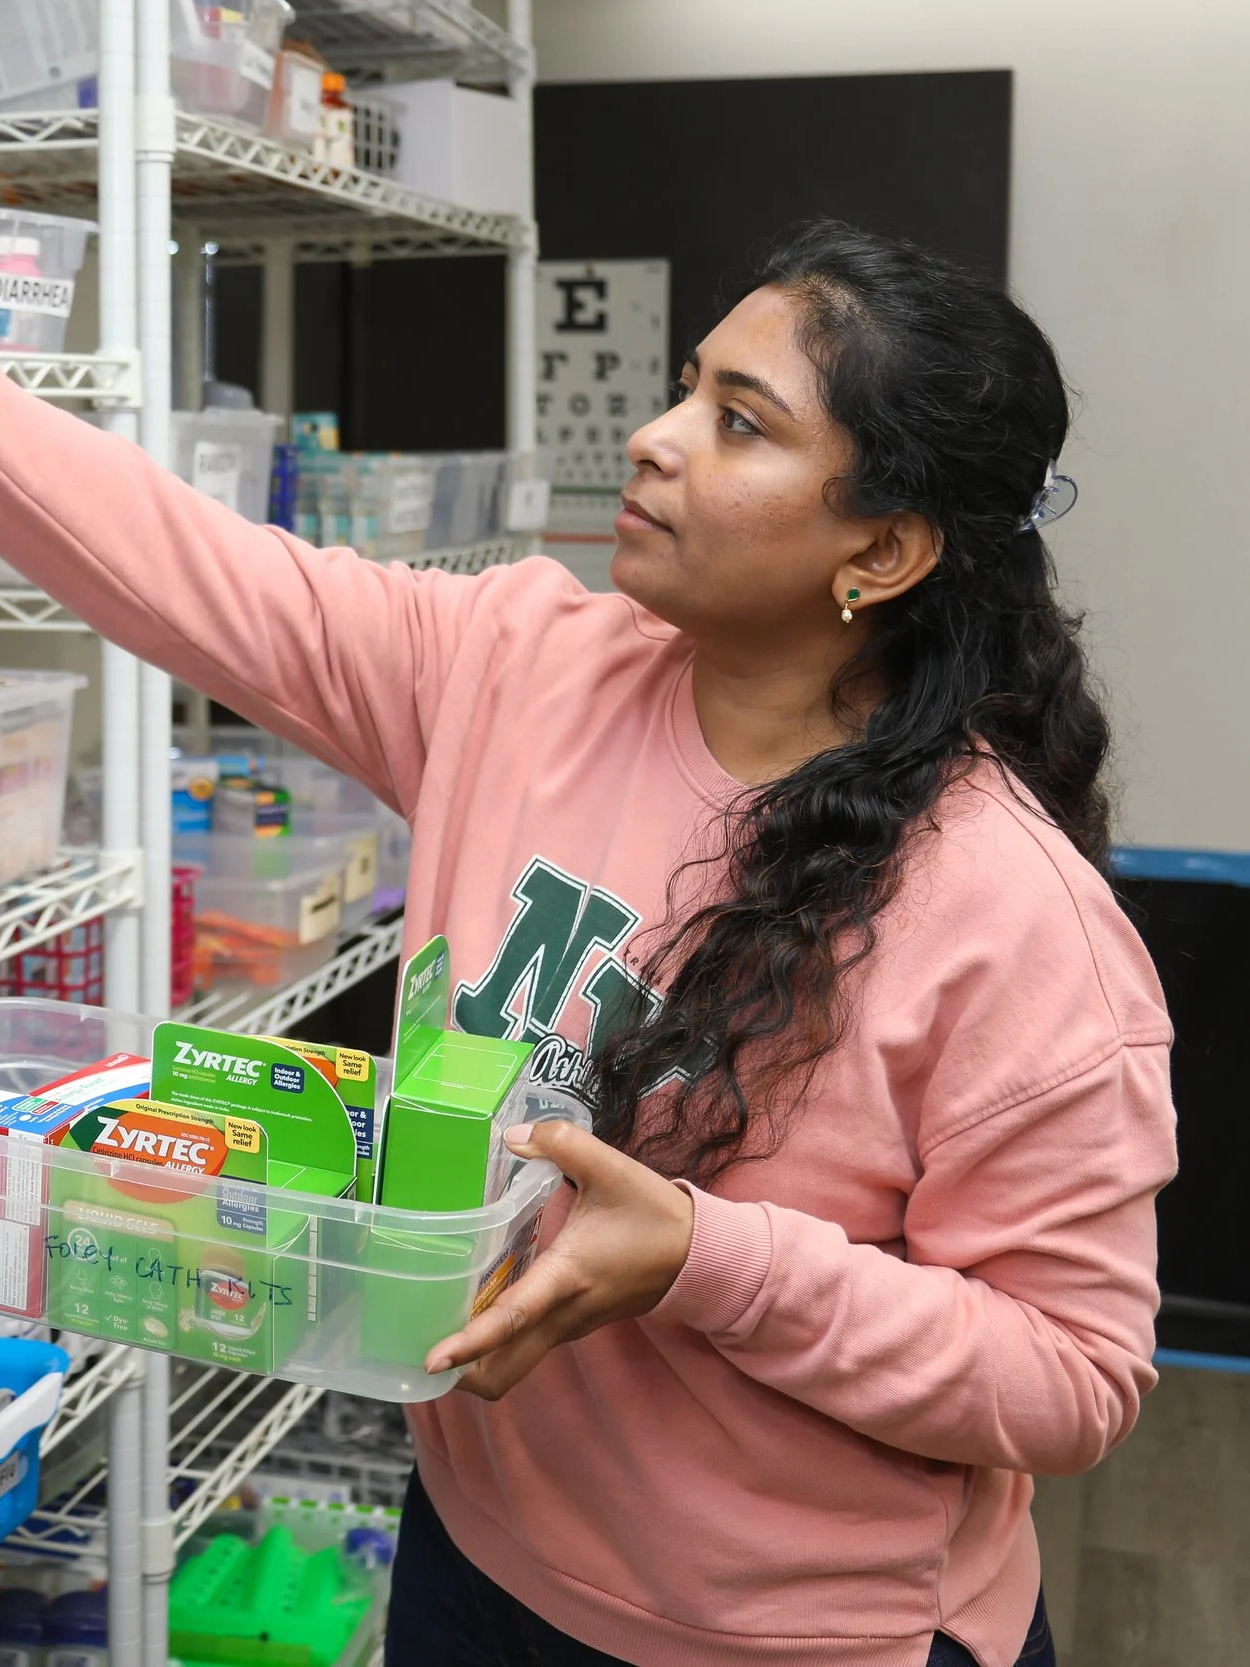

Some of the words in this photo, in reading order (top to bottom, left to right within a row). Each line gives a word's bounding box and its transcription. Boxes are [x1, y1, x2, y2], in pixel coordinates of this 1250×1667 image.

[554, 278, 608, 334] E
[303, 1047, 326, 1056] Strength
[173, 1040, 261, 1079] ZYRTEC
[339, 1053, 352, 1061] New
[353, 1054, 367, 1062] look
[343, 1060, 363, 1069] Same
[179, 1073, 188, 1081] mg
[274, 1066, 295, 1077] Indoor
[343, 1068, 362, 1076] relief
[226, 1074, 258, 1087] ALLERGY
[274, 1074, 300, 1084] Outdoor
[273, 1079, 301, 1091] Allergies
[135, 1103, 157, 1113] Original
[157, 1107, 190, 1120] Prescription
[190, 1113, 215, 1125] Strength
[228, 1121, 242, 1130] New
[94, 1115, 207, 1165] ZYRTEC
[232, 1129, 253, 1140] Same
[233, 1138, 252, 1148] relief
[92, 1146, 123, 1159] Cetirizine
[164, 1160, 206, 1175] ALLERGY
[221, 1188, 258, 1204] Outdoor
[221, 1199, 260, 1213] Allergies
[221, 1215, 233, 1226] 10
[242, 1217, 264, 1227] Strength
[242, 1223, 264, 1233] Capsules
[135, 1257, 202, 1289] CATH
[210, 1282, 245, 1301] ZYRTEC
[73, 1302, 89, 1315] 12
[112, 1315, 130, 1325] Dye-
[234, 1313, 245, 1322] 12
[112, 1322, 128, 1331] Free
[212, 1342, 227, 1353] 12
